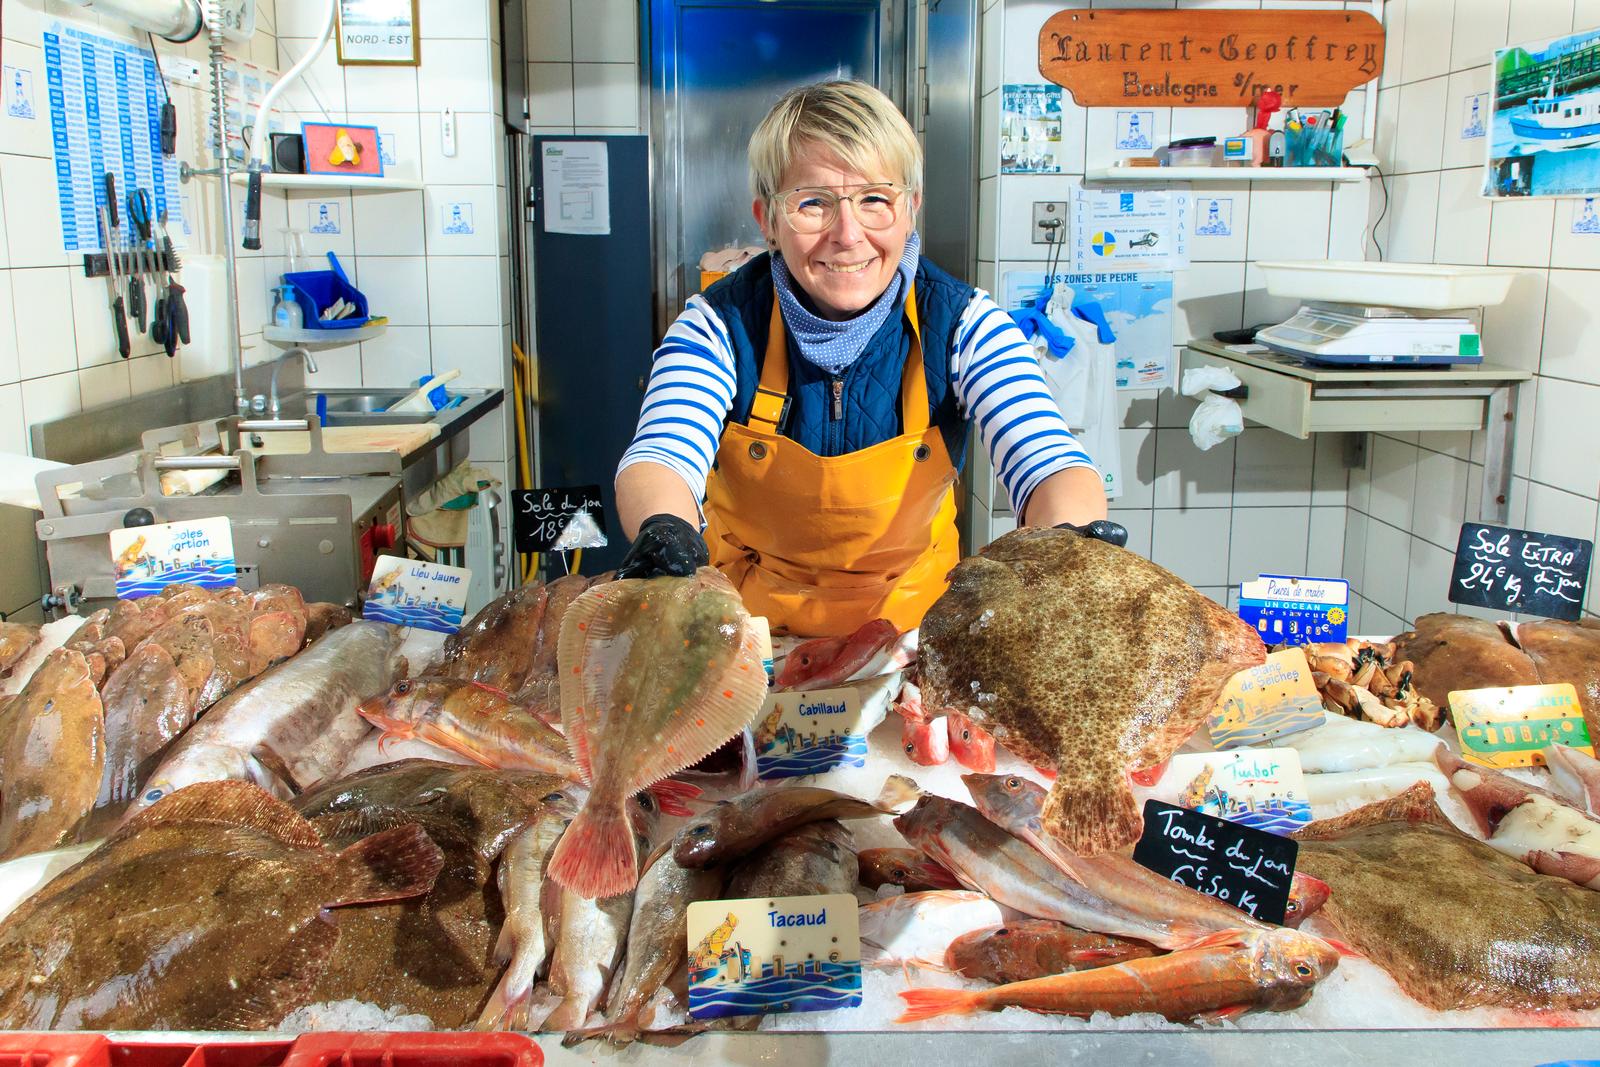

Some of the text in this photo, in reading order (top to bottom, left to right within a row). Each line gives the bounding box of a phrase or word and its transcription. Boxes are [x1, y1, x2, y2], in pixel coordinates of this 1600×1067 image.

[346, 35, 379, 44] NORD
[388, 35, 410, 45] EST
[1122, 72, 1218, 103] Boulogne
[1064, 274, 1092, 284] ZONES
[1095, 273, 1107, 283] DE
[522, 493, 555, 513] Sole
[1468, 528, 1511, 558] Sole
[411, 567, 461, 584] Lieu Jaune
[1292, 584, 1303, 596] de
[1304, 585, 1325, 598] crabe
[1260, 607, 1275, 615] de
[1282, 601, 1321, 611] OCEAN
[1241, 669, 1299, 692] de Seiches
[798, 701, 847, 716] Cabillaud
[1157, 810, 1215, 850] Tombe
[767, 907, 827, 928] Tacaud
